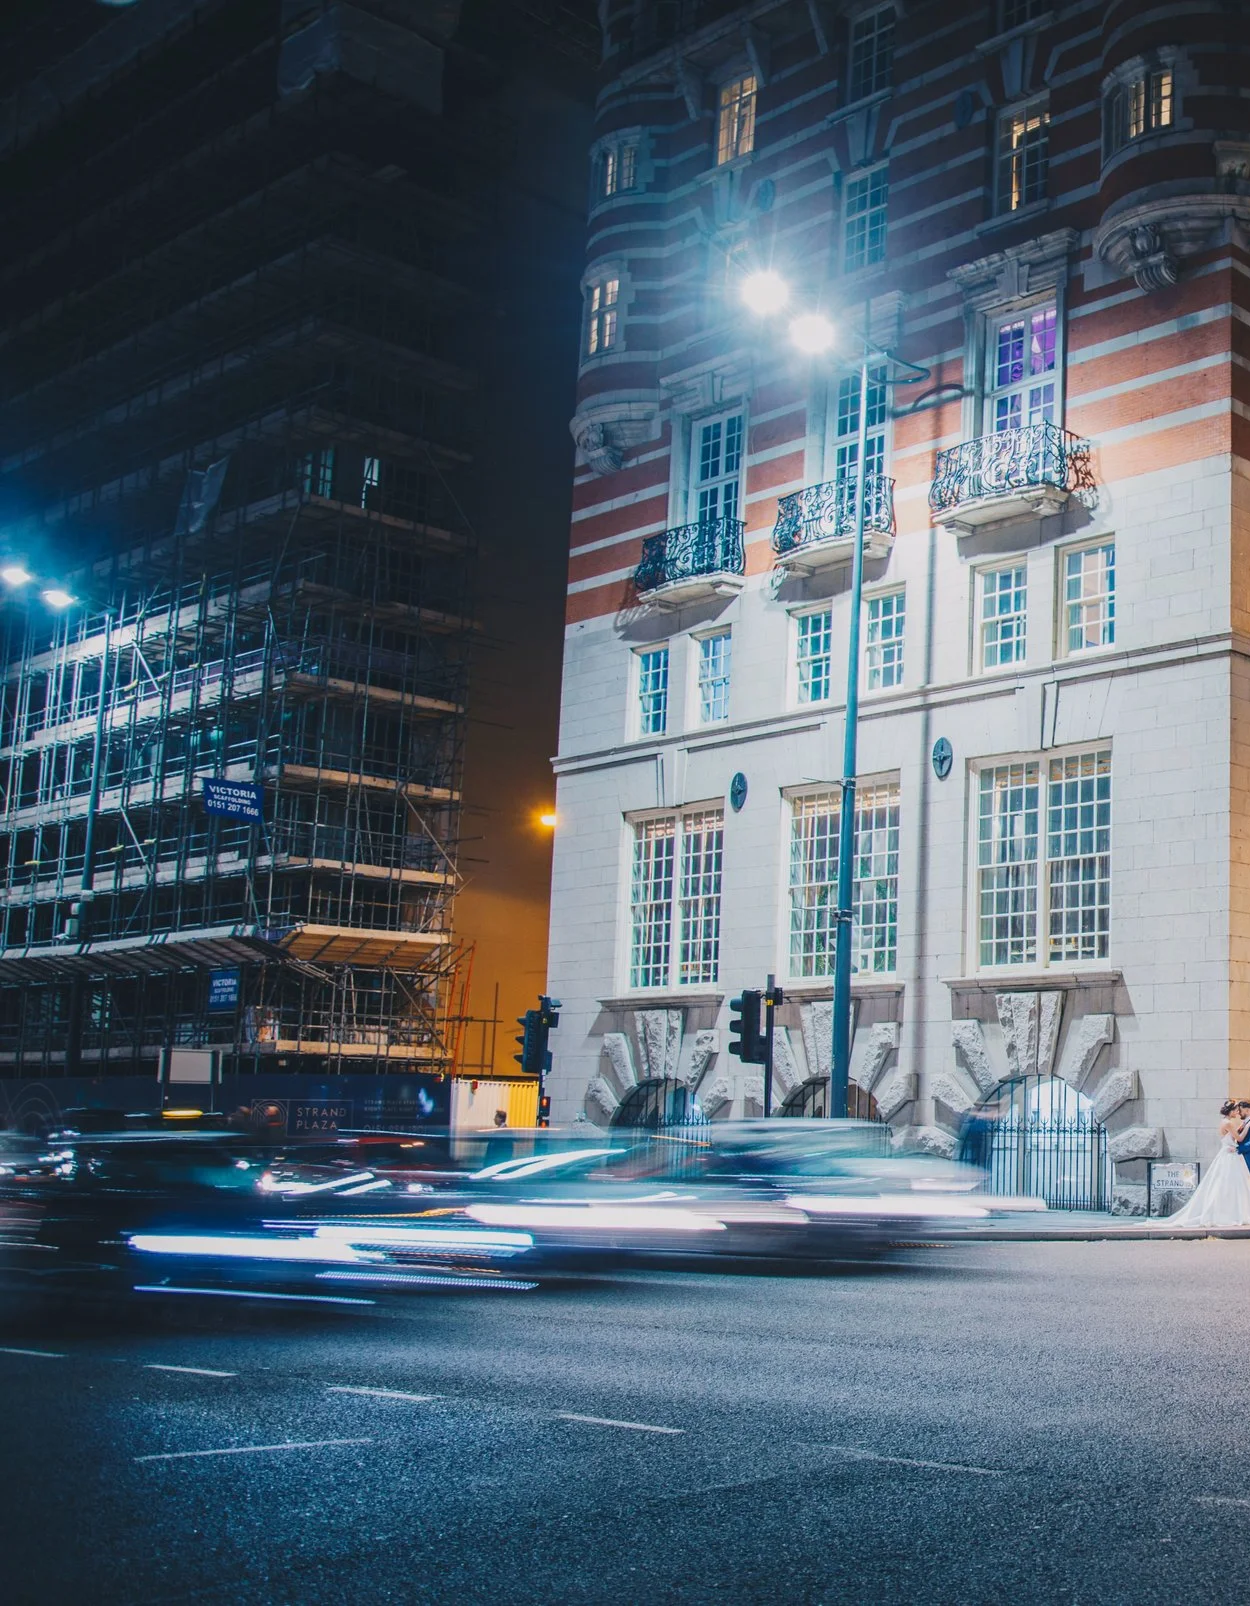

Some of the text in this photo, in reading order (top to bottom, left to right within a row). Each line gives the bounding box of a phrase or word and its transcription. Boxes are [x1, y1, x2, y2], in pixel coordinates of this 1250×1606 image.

[208, 785, 257, 799] VICTORIA
[213, 794, 252, 805] SCAFFOLDING
[207, 799, 259, 816] 0151 207 1666
[296, 1107, 346, 1117] STRAND
[296, 1120, 338, 1130] PLAZA
[1167, 1170, 1181, 1178] THE
[1156, 1179, 1184, 1187] STRAND
